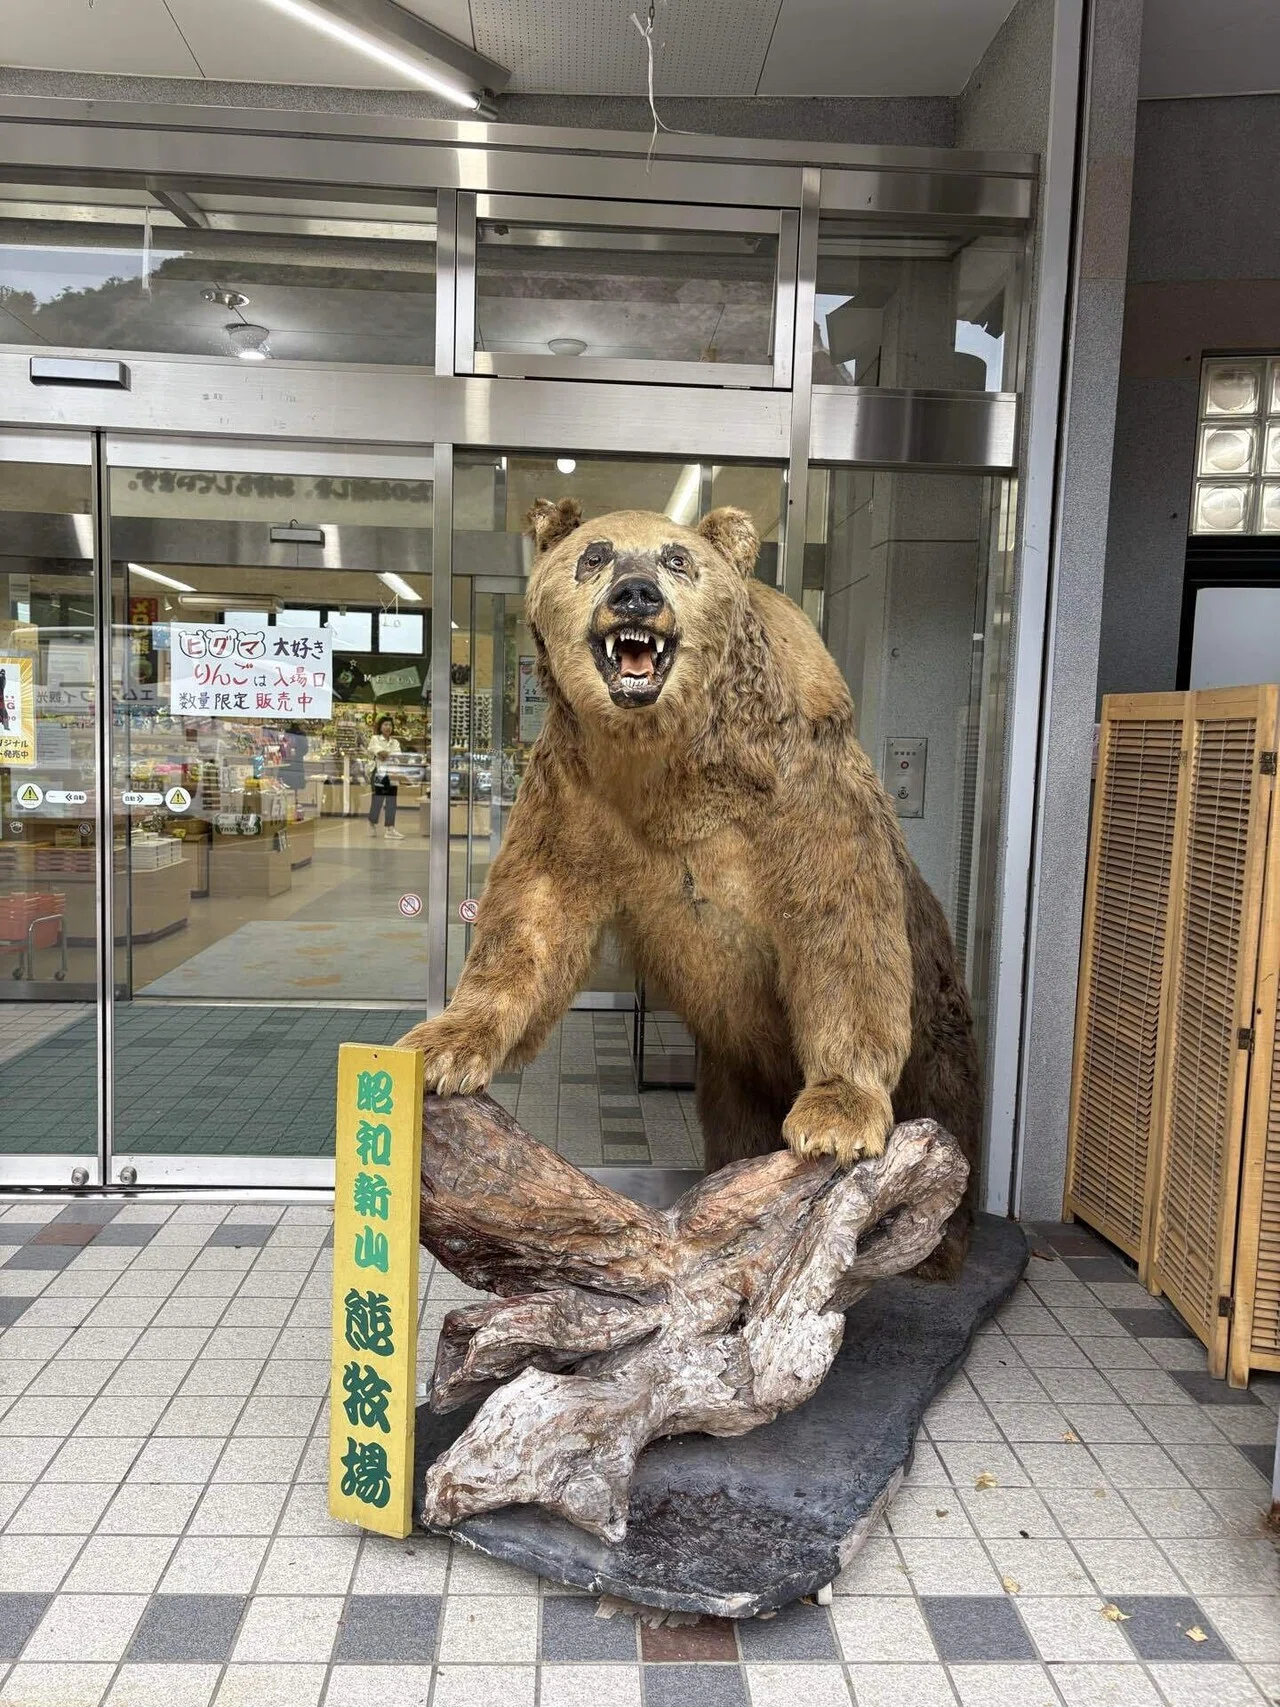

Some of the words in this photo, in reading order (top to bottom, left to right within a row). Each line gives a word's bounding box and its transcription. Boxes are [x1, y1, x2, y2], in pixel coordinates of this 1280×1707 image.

[354, 1070, 394, 1273] 昭和新山
[340, 1287, 395, 1509] 熊牧場
